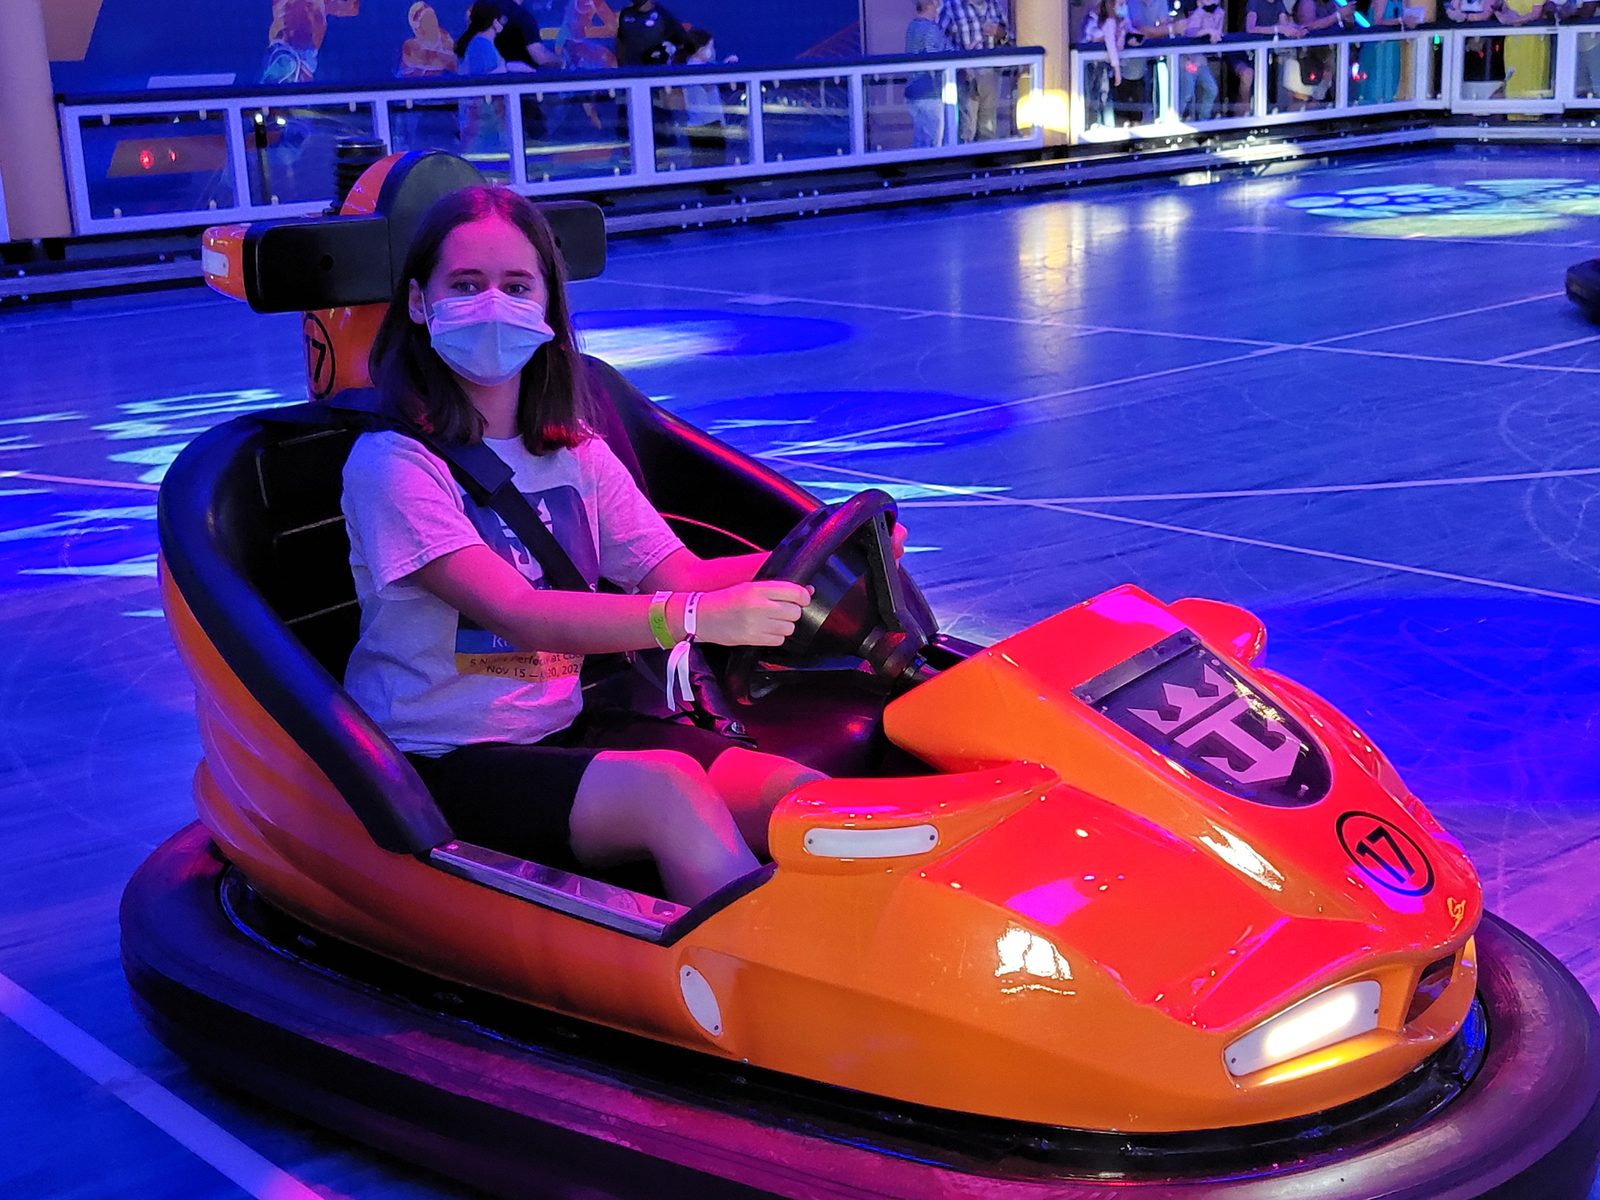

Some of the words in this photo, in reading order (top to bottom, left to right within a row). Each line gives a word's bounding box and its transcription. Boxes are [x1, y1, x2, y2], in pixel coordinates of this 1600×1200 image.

[305, 333, 327, 384] 17
[486, 665, 509, 675] Nov
[514, 667, 526, 678] 15
[561, 663, 582, 676] 202
[1355, 825, 1416, 884] 17
